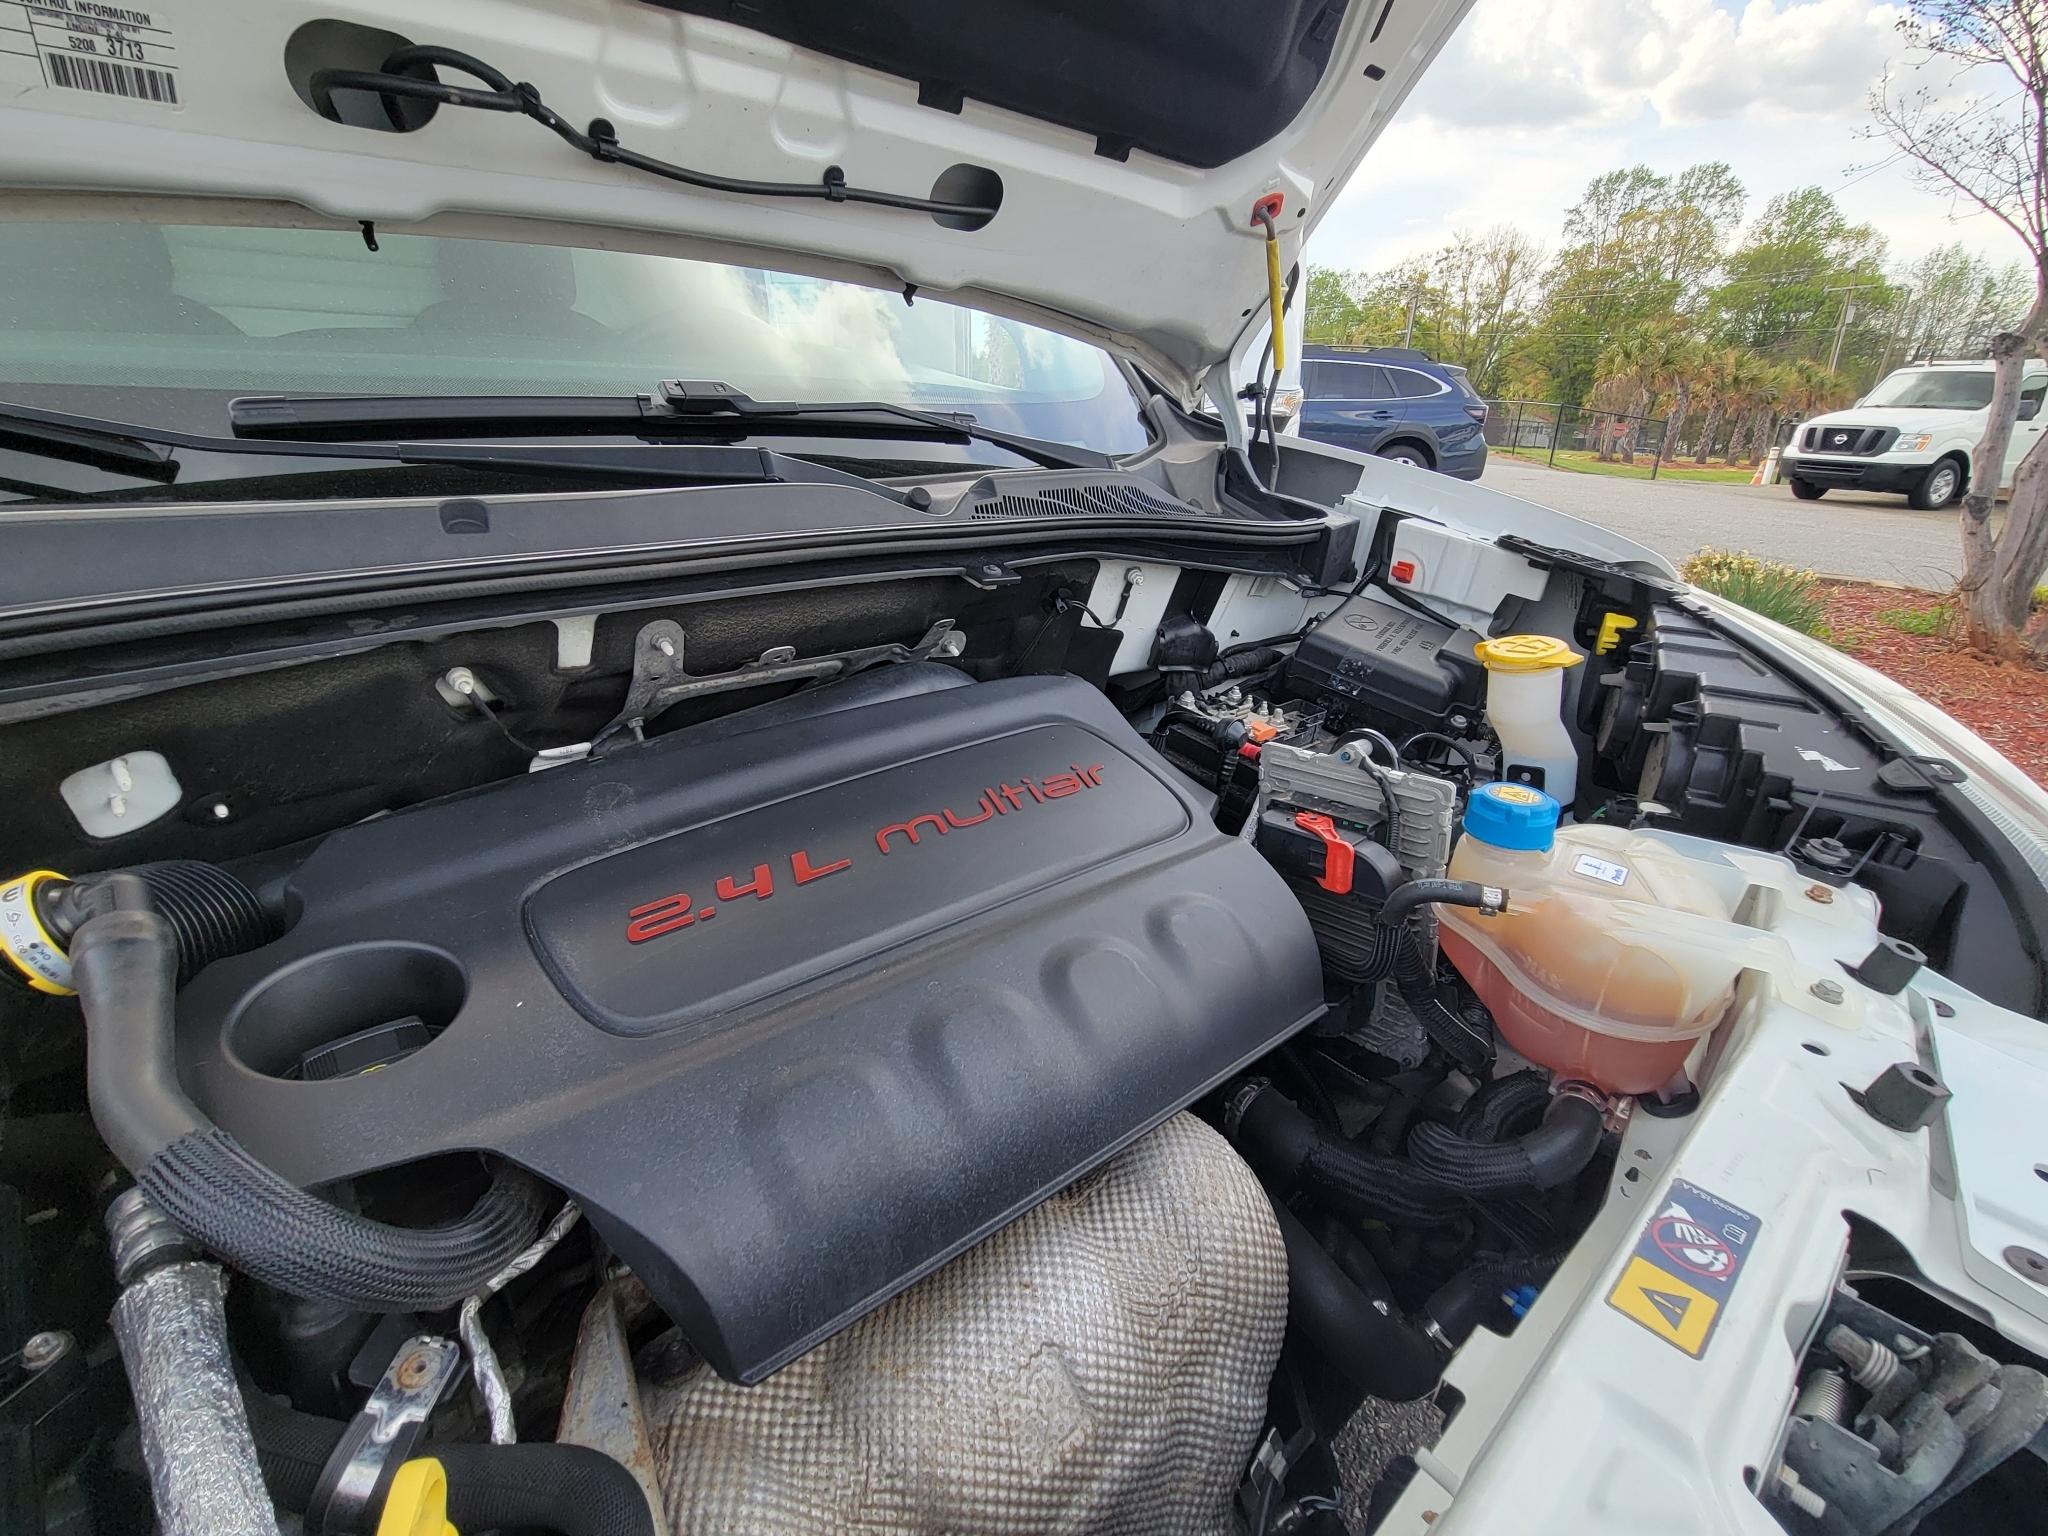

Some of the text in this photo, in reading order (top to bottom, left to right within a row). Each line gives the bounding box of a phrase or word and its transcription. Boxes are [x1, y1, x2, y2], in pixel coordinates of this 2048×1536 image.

[74, 1, 151, 26] INFORMATION
[106, 37, 144, 60] 3713
[875, 763, 1105, 854] multiair
